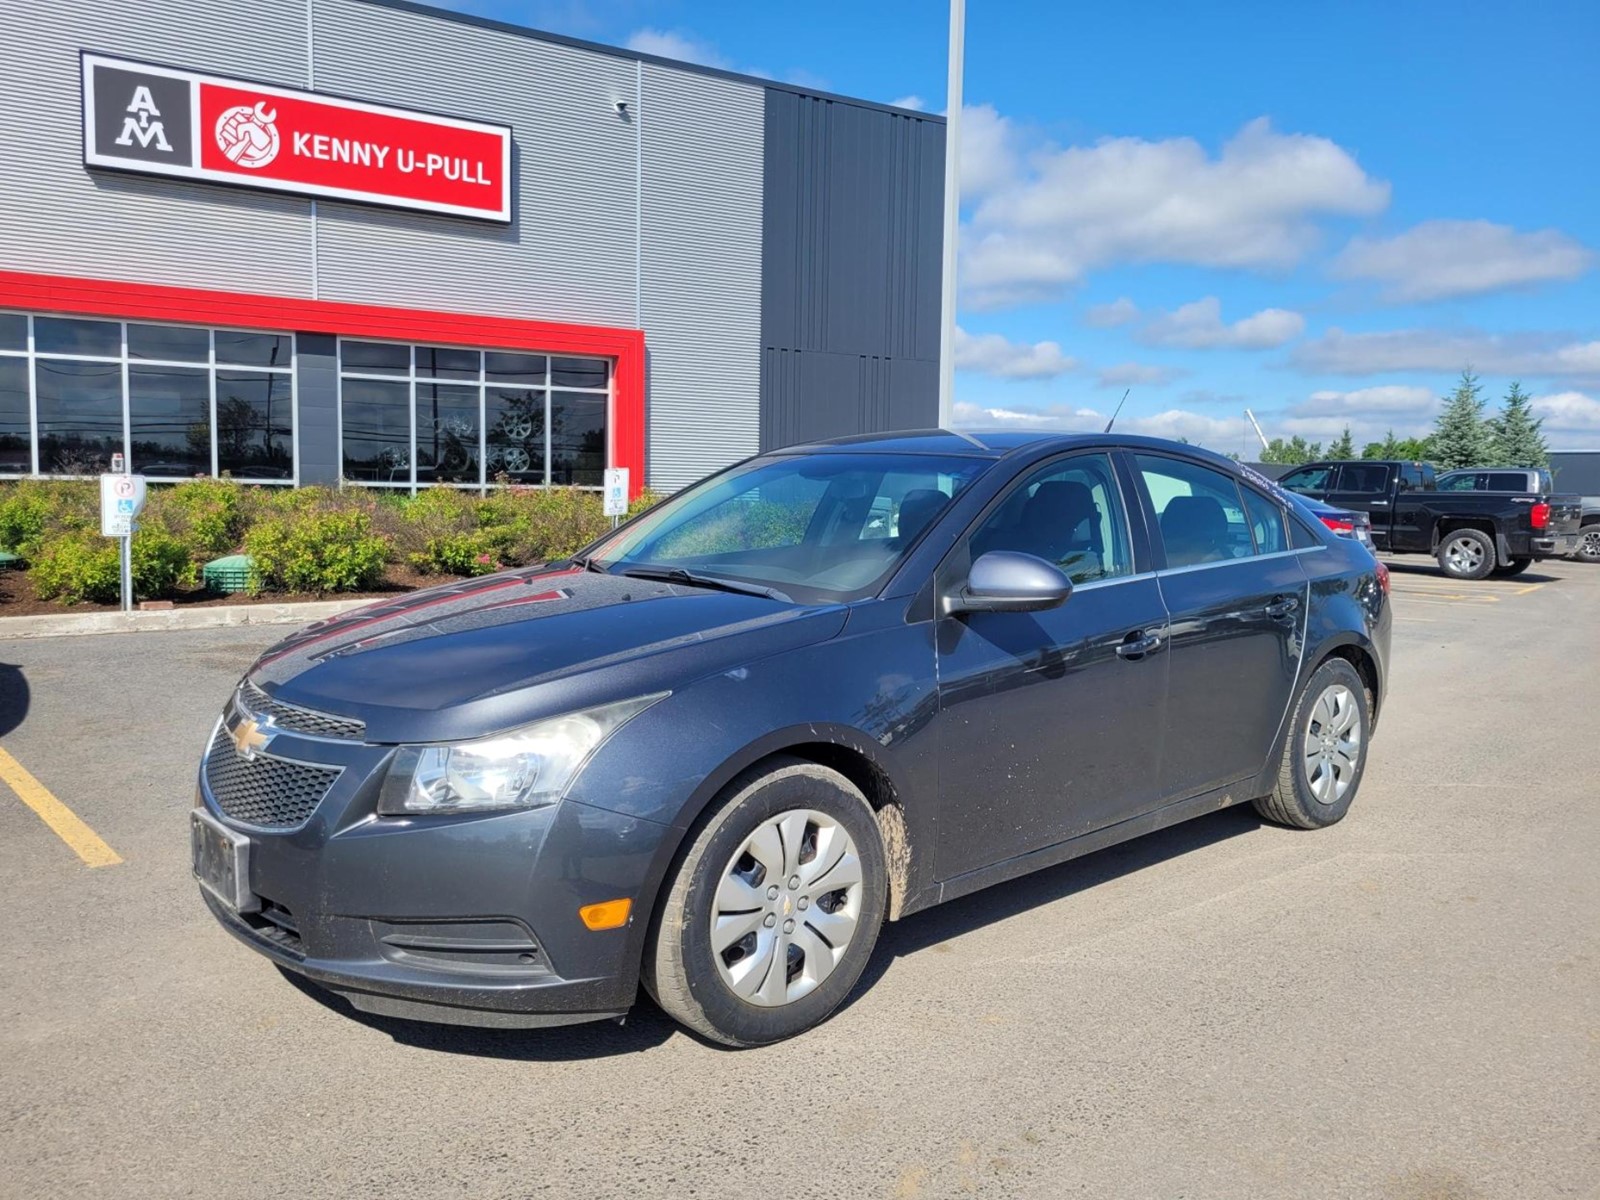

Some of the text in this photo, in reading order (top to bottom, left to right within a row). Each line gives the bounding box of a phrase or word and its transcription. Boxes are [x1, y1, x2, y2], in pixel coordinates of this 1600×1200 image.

[293, 131, 492, 186] KENNY U-PULL
[120, 482, 131, 494] P
